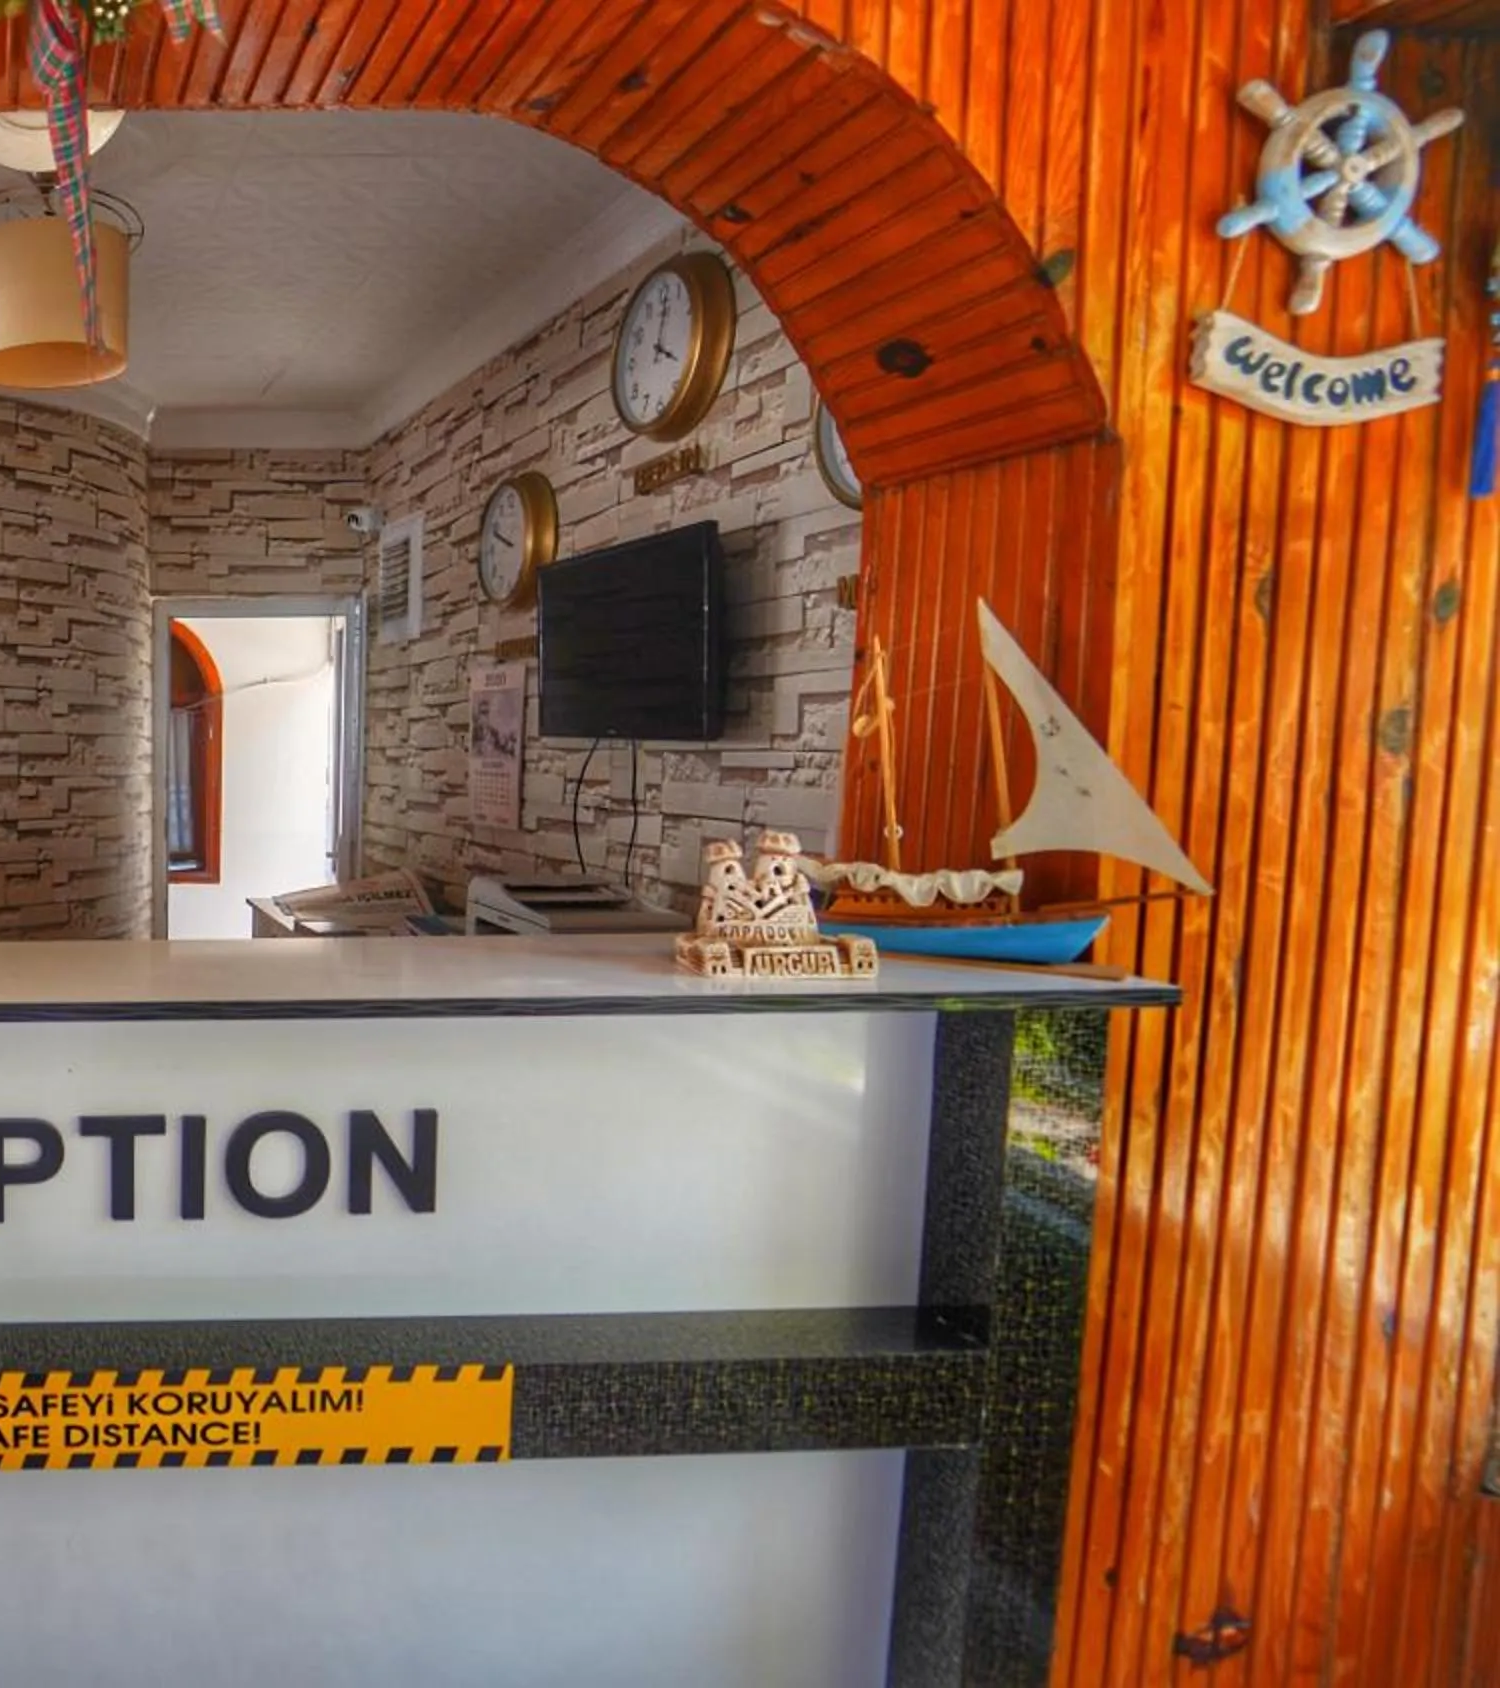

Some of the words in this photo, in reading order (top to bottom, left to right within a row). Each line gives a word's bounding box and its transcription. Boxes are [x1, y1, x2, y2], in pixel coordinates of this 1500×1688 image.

[1225, 336, 1417, 405] welcome
[127, 1389, 364, 1416] KORUYALIM!
[63, 1421, 261, 1448] DISTANCE!
